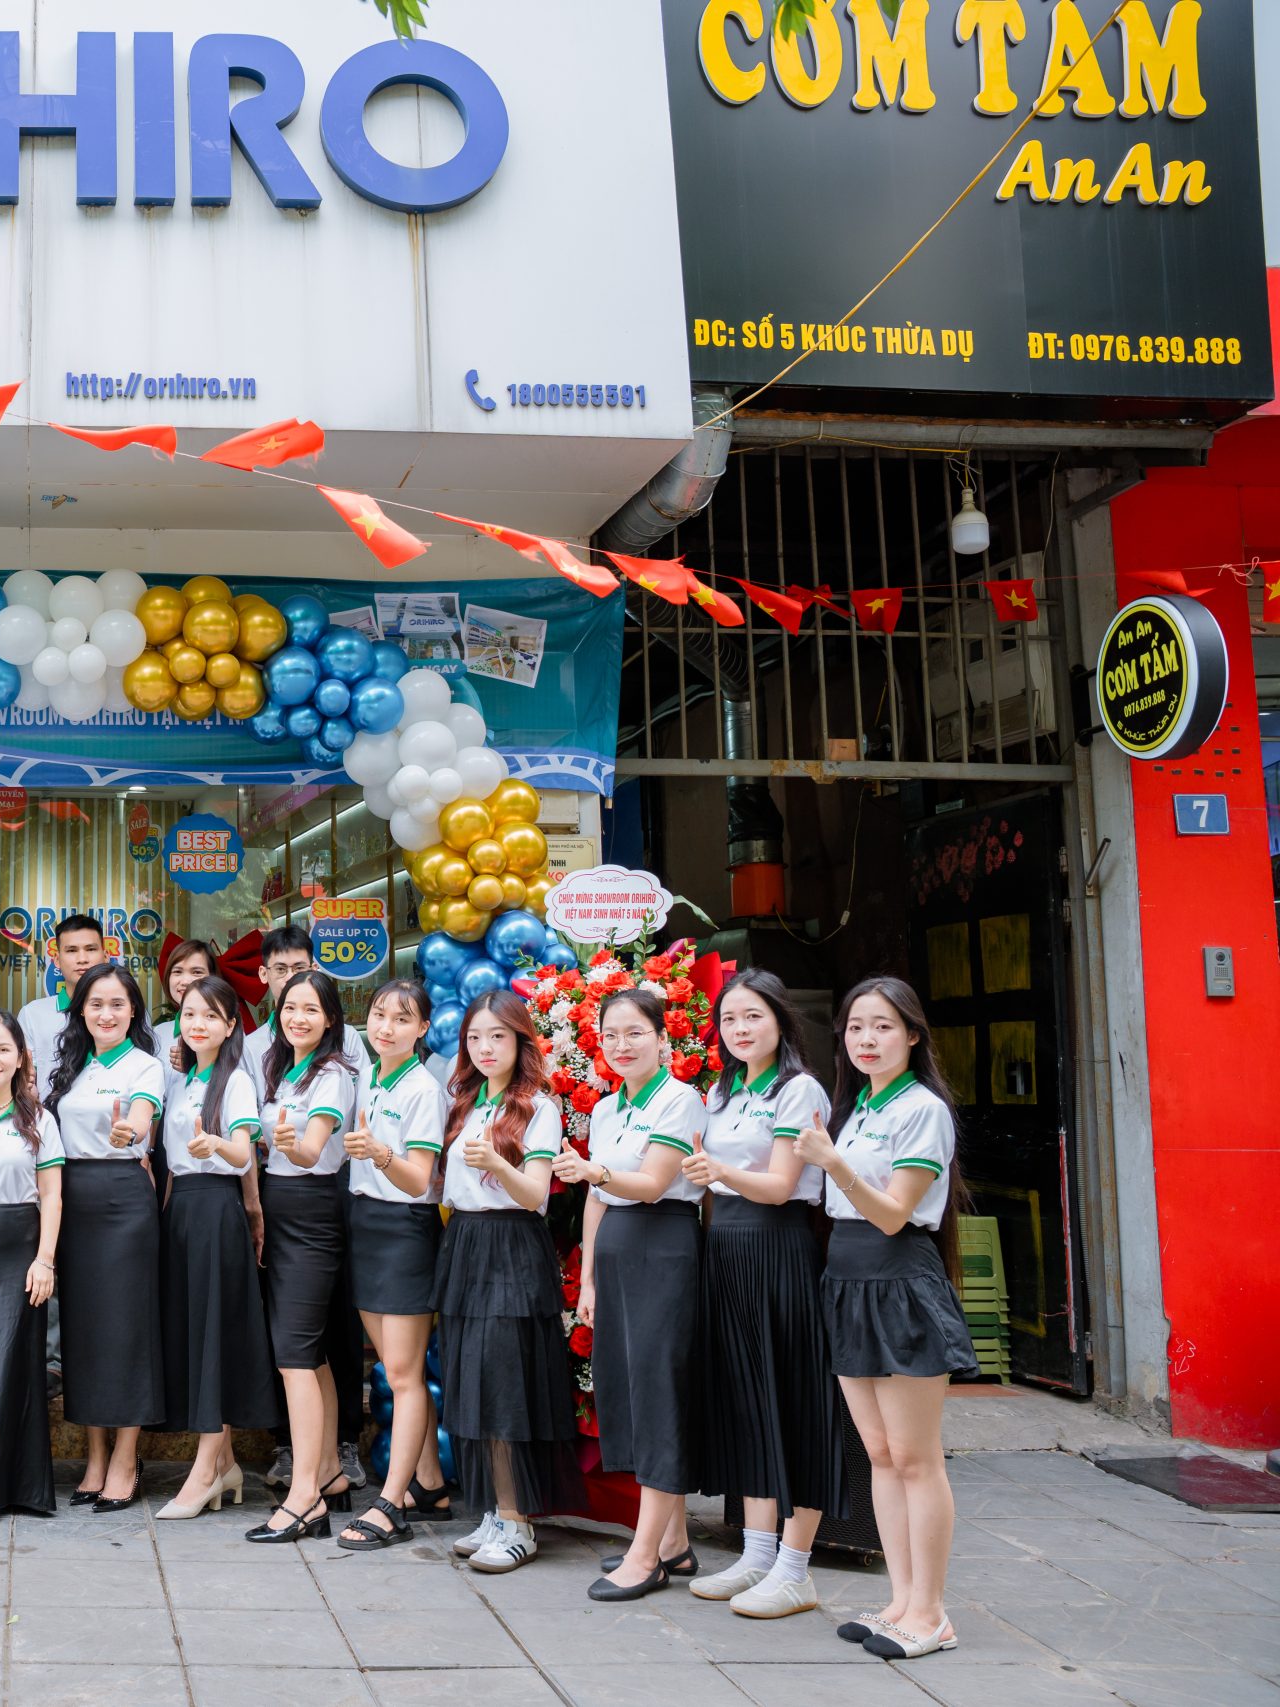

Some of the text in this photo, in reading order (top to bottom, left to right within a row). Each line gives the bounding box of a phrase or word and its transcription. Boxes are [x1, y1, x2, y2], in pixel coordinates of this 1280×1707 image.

[996, 139, 1212, 206] An An
[694, 318, 736, 347] ĐC:
[741, 313, 774, 349] SỐ
[780, 323, 795, 350] 5
[872, 321, 937, 356] THỪA
[941, 329, 974, 362] DỤ
[1027, 331, 1242, 365] ĐT: 0976.839.888
[66, 372, 257, 401] http://orihiro.vn
[507, 383, 646, 407] 1800555591
[1118, 620, 1152, 648] An An
[1105, 631, 1179, 701] CƠM TẤM
[1123, 689, 1166, 717] 0976.839.888
[130, 818, 148, 831] SALE
[1192, 800, 1209, 828] 7
[132, 845, 155, 857] 50%
[177, 831, 231, 851] BEST
[170, 854, 227, 872] PRICE
[312, 899, 384, 918] SUPER
[594, 893, 630, 904] SHOWROOM
[631, 893, 657, 904] ORIHIRO
[564, 907, 578, 921] VIỆT
[578, 908, 592, 919] NAM
[593, 908, 608, 919] SINH
[609, 907, 625, 921] NHẬT
[626, 909, 631, 919] 5
[318, 928, 378, 937] SALE UP TO
[319, 941, 377, 963] 50%
